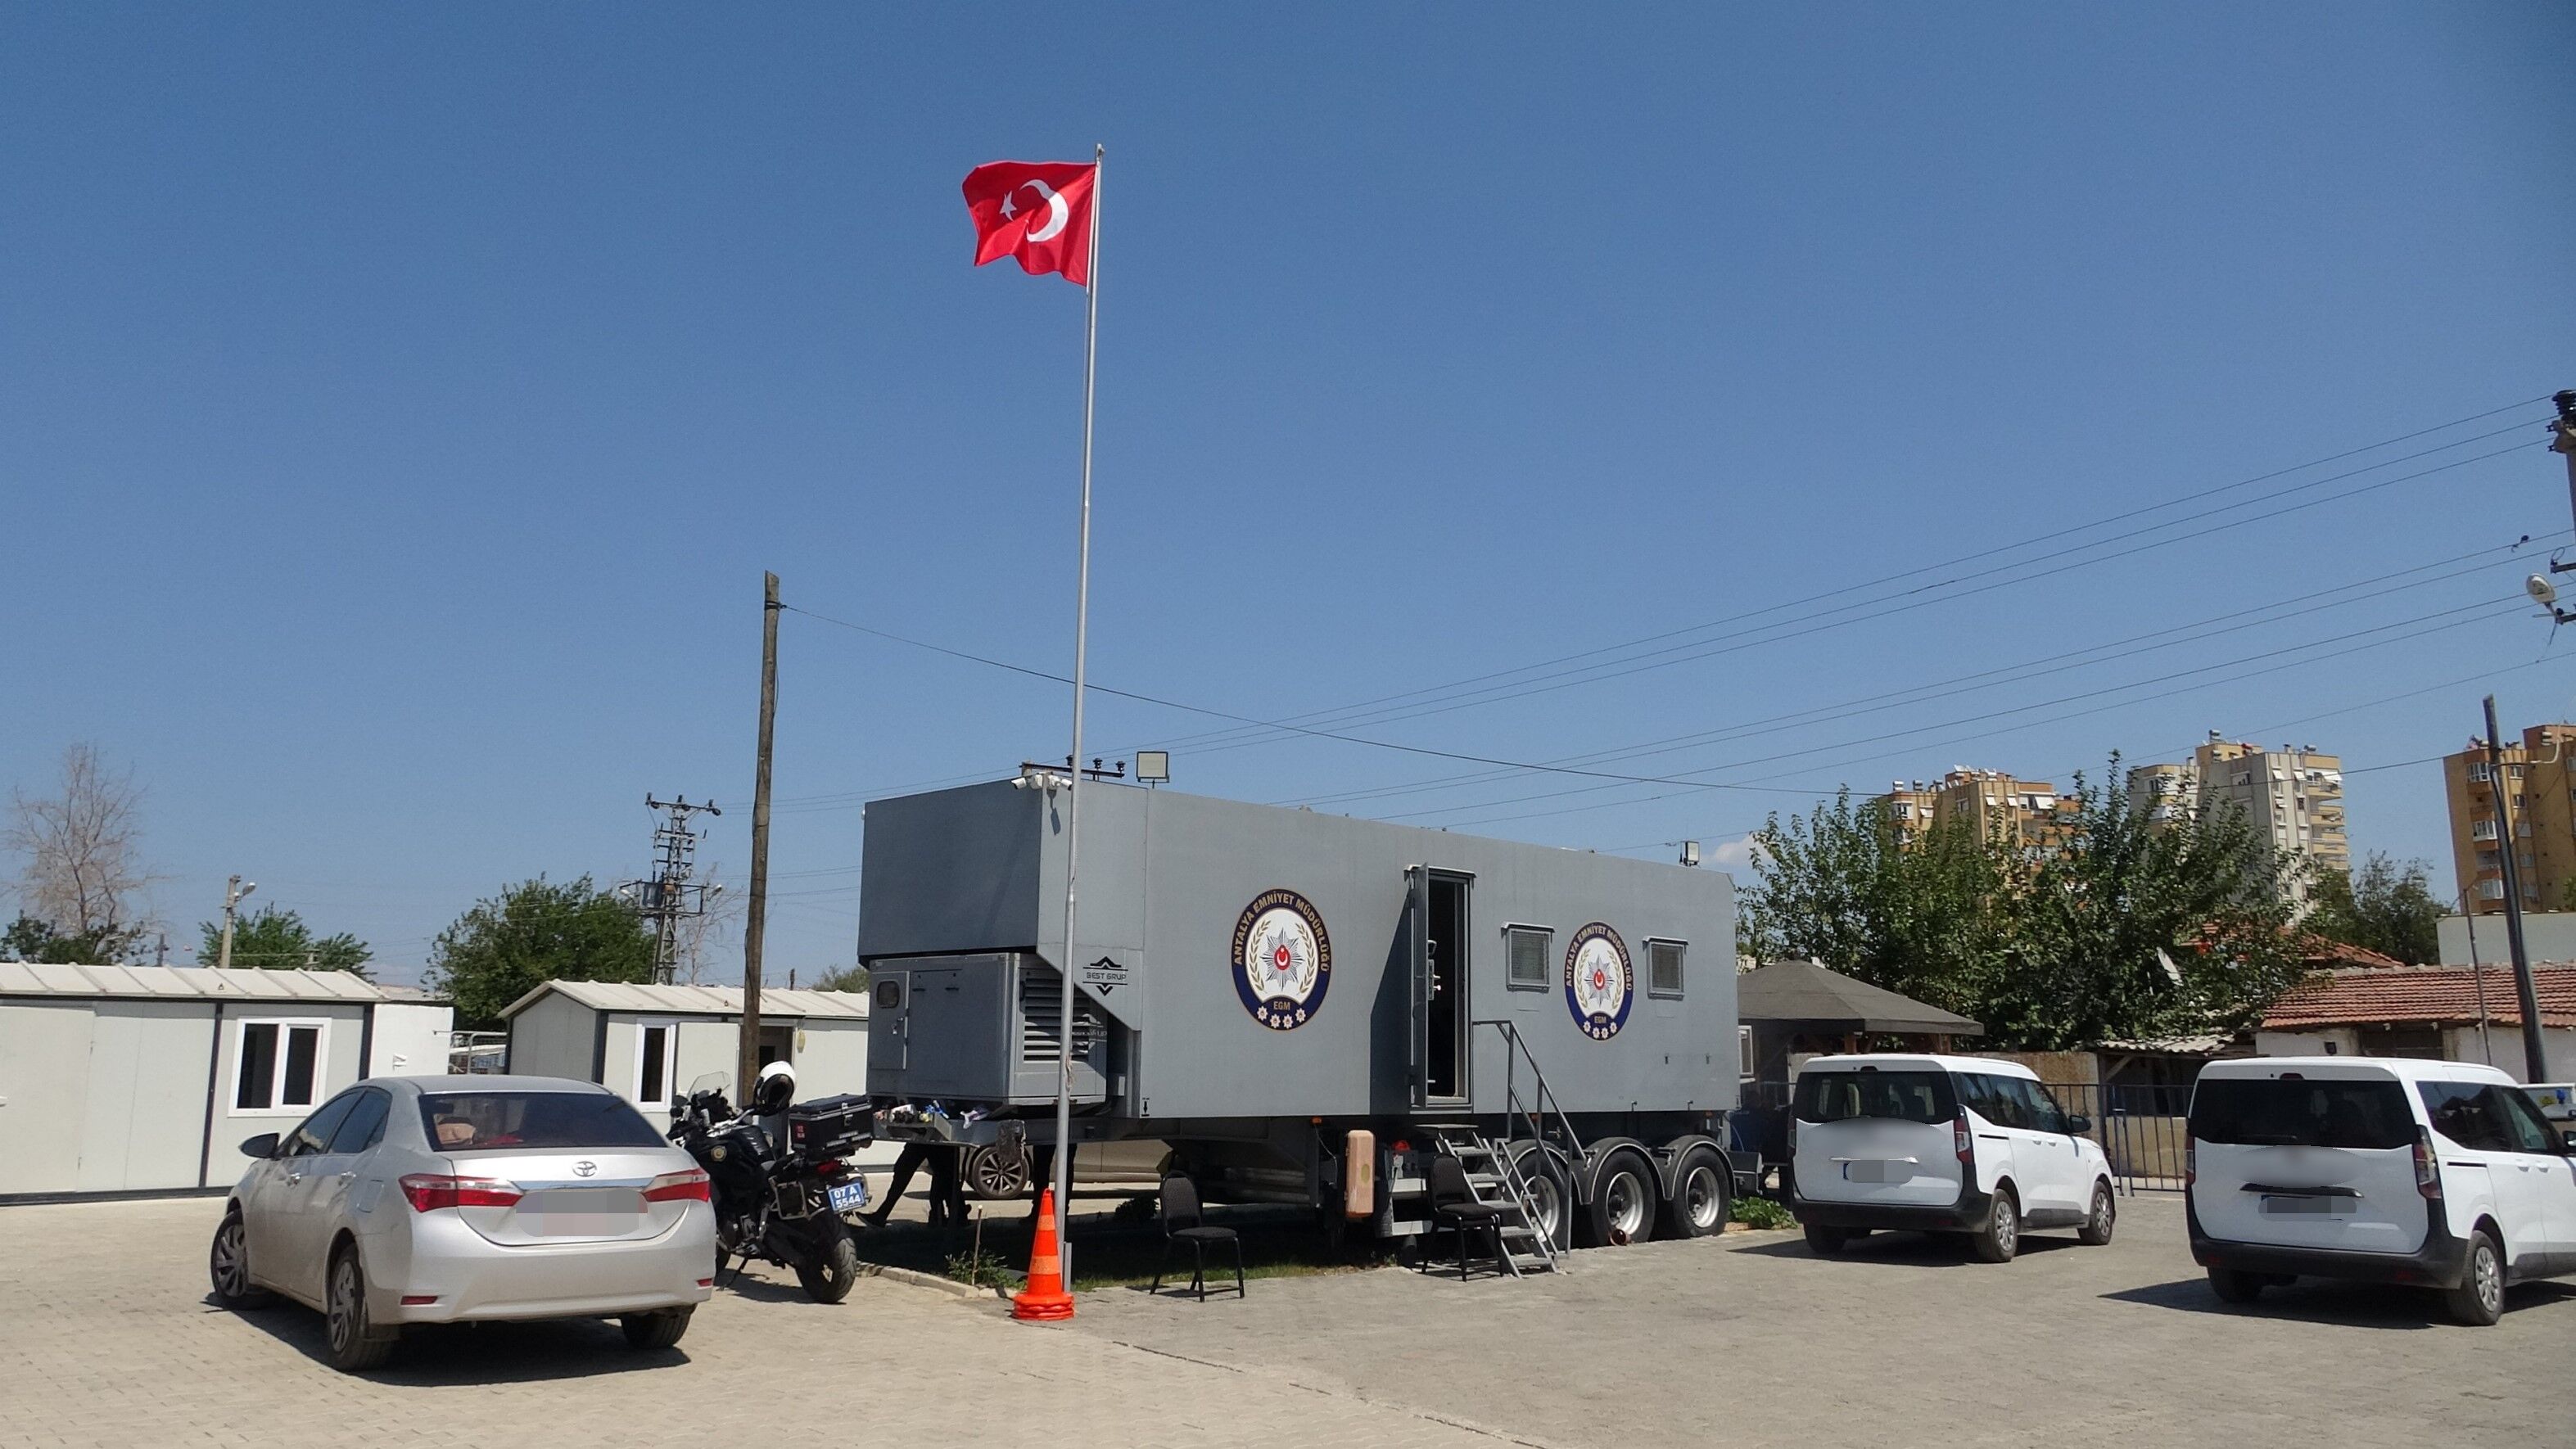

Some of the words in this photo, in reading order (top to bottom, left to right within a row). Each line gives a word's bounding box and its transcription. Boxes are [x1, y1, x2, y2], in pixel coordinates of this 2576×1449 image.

[1234, 913, 1254, 965] ANTALYA
[1254, 892, 1295, 914] EMNİYET
[1295, 898, 1330, 972] MÜDÜRLÜĞÜ
[1566, 941, 1579, 987] ANTALYA
[1273, 1001, 1290, 1010] EGM
[834, 1189, 846, 1198] 07
[849, 1186, 857, 1195] A
